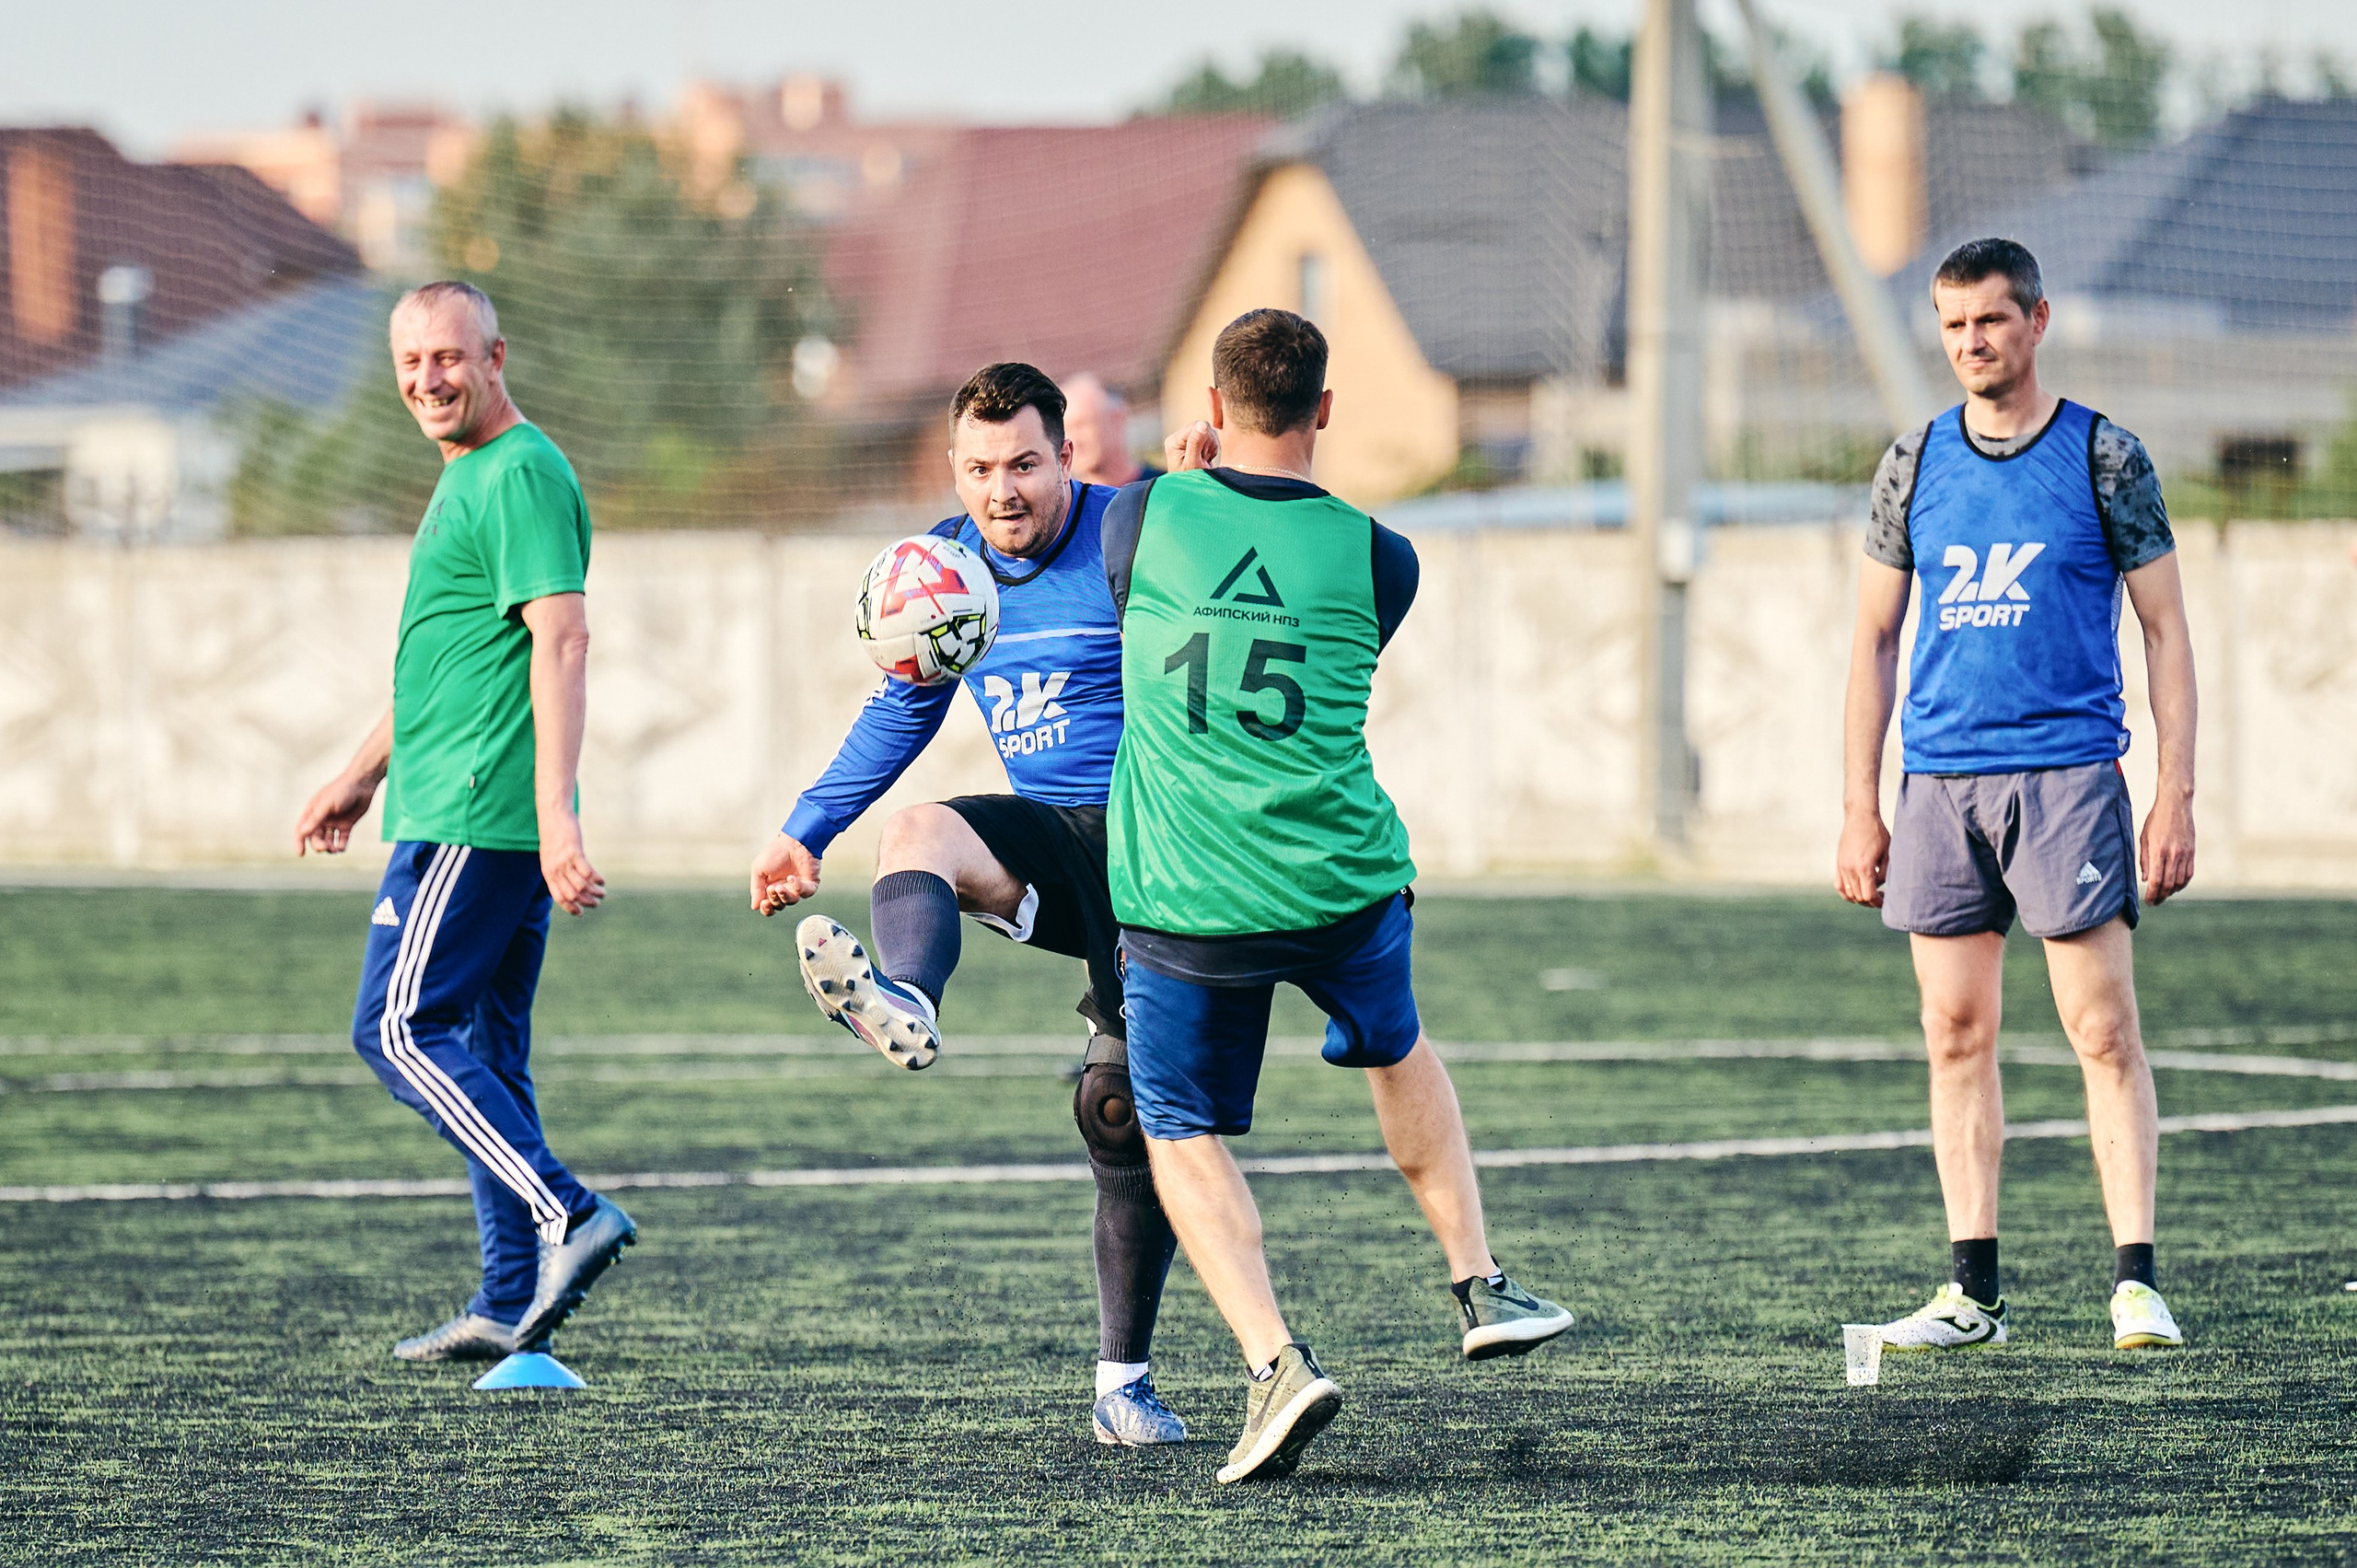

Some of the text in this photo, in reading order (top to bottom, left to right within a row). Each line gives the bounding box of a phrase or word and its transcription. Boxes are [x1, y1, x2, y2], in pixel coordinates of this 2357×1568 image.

[1937, 542, 2047, 604] 2K
[1193, 606, 1300, 628] АФИПСКИЙ НПЗ
[1939, 604, 2030, 631] SPORT
[984, 671, 1073, 733] 2K
[1164, 633, 1306, 741] 15
[999, 719, 1071, 759] SPORT
